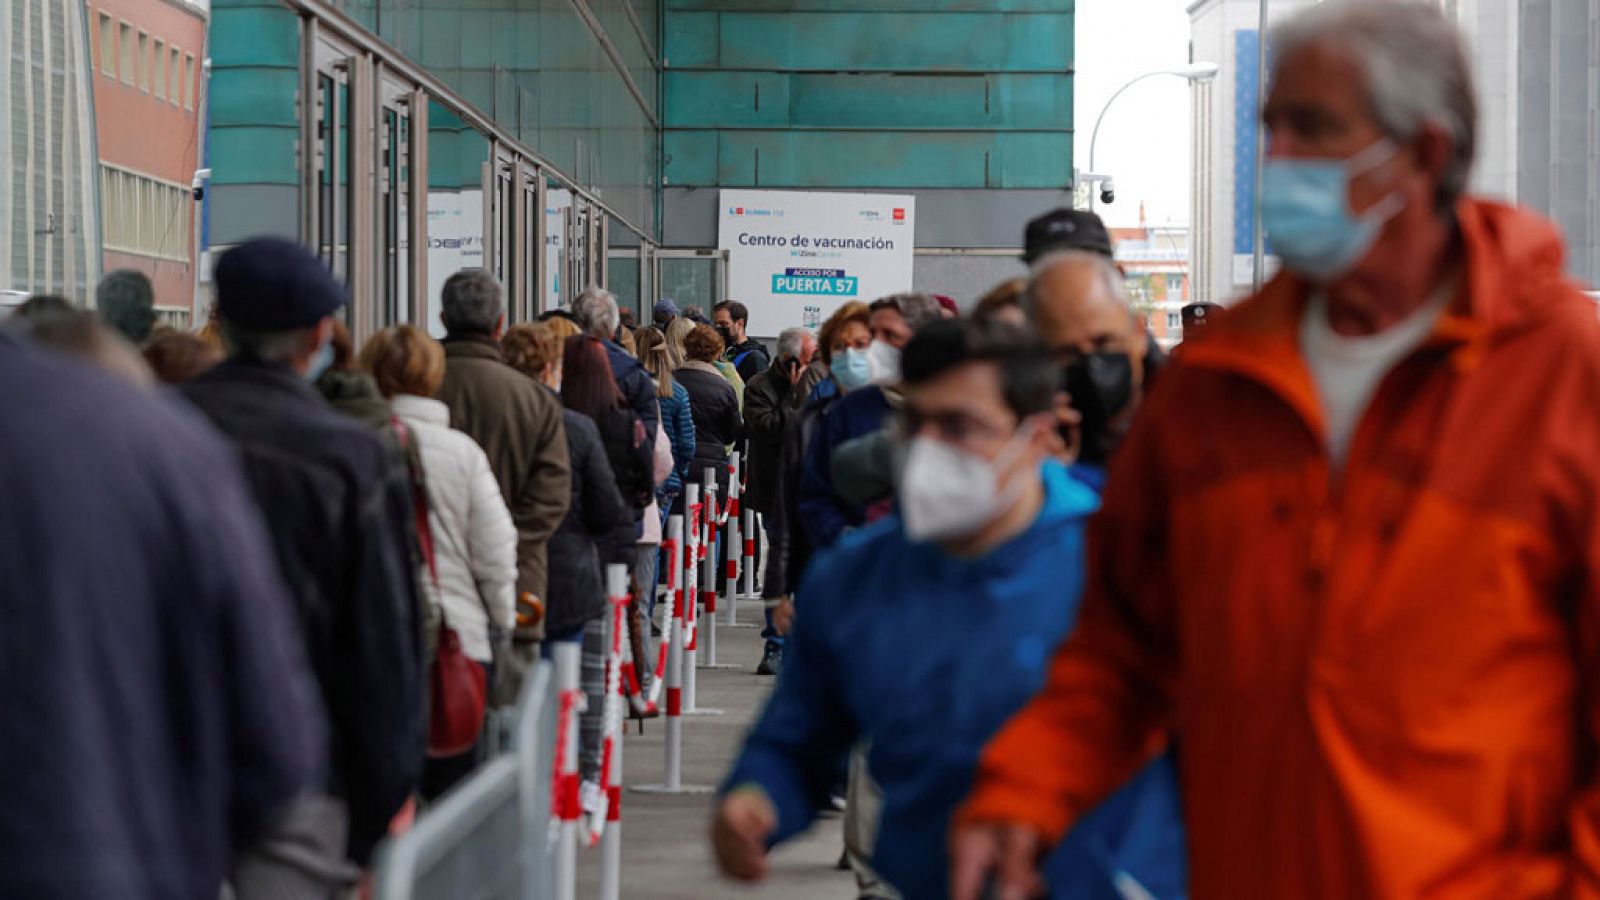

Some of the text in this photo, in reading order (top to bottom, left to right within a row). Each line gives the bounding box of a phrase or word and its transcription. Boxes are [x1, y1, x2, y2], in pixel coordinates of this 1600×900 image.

[738, 232, 894, 250] Centro de vacunación
[793, 269, 820, 277] ACCESO
[776, 277, 854, 293] PUERTA 57
